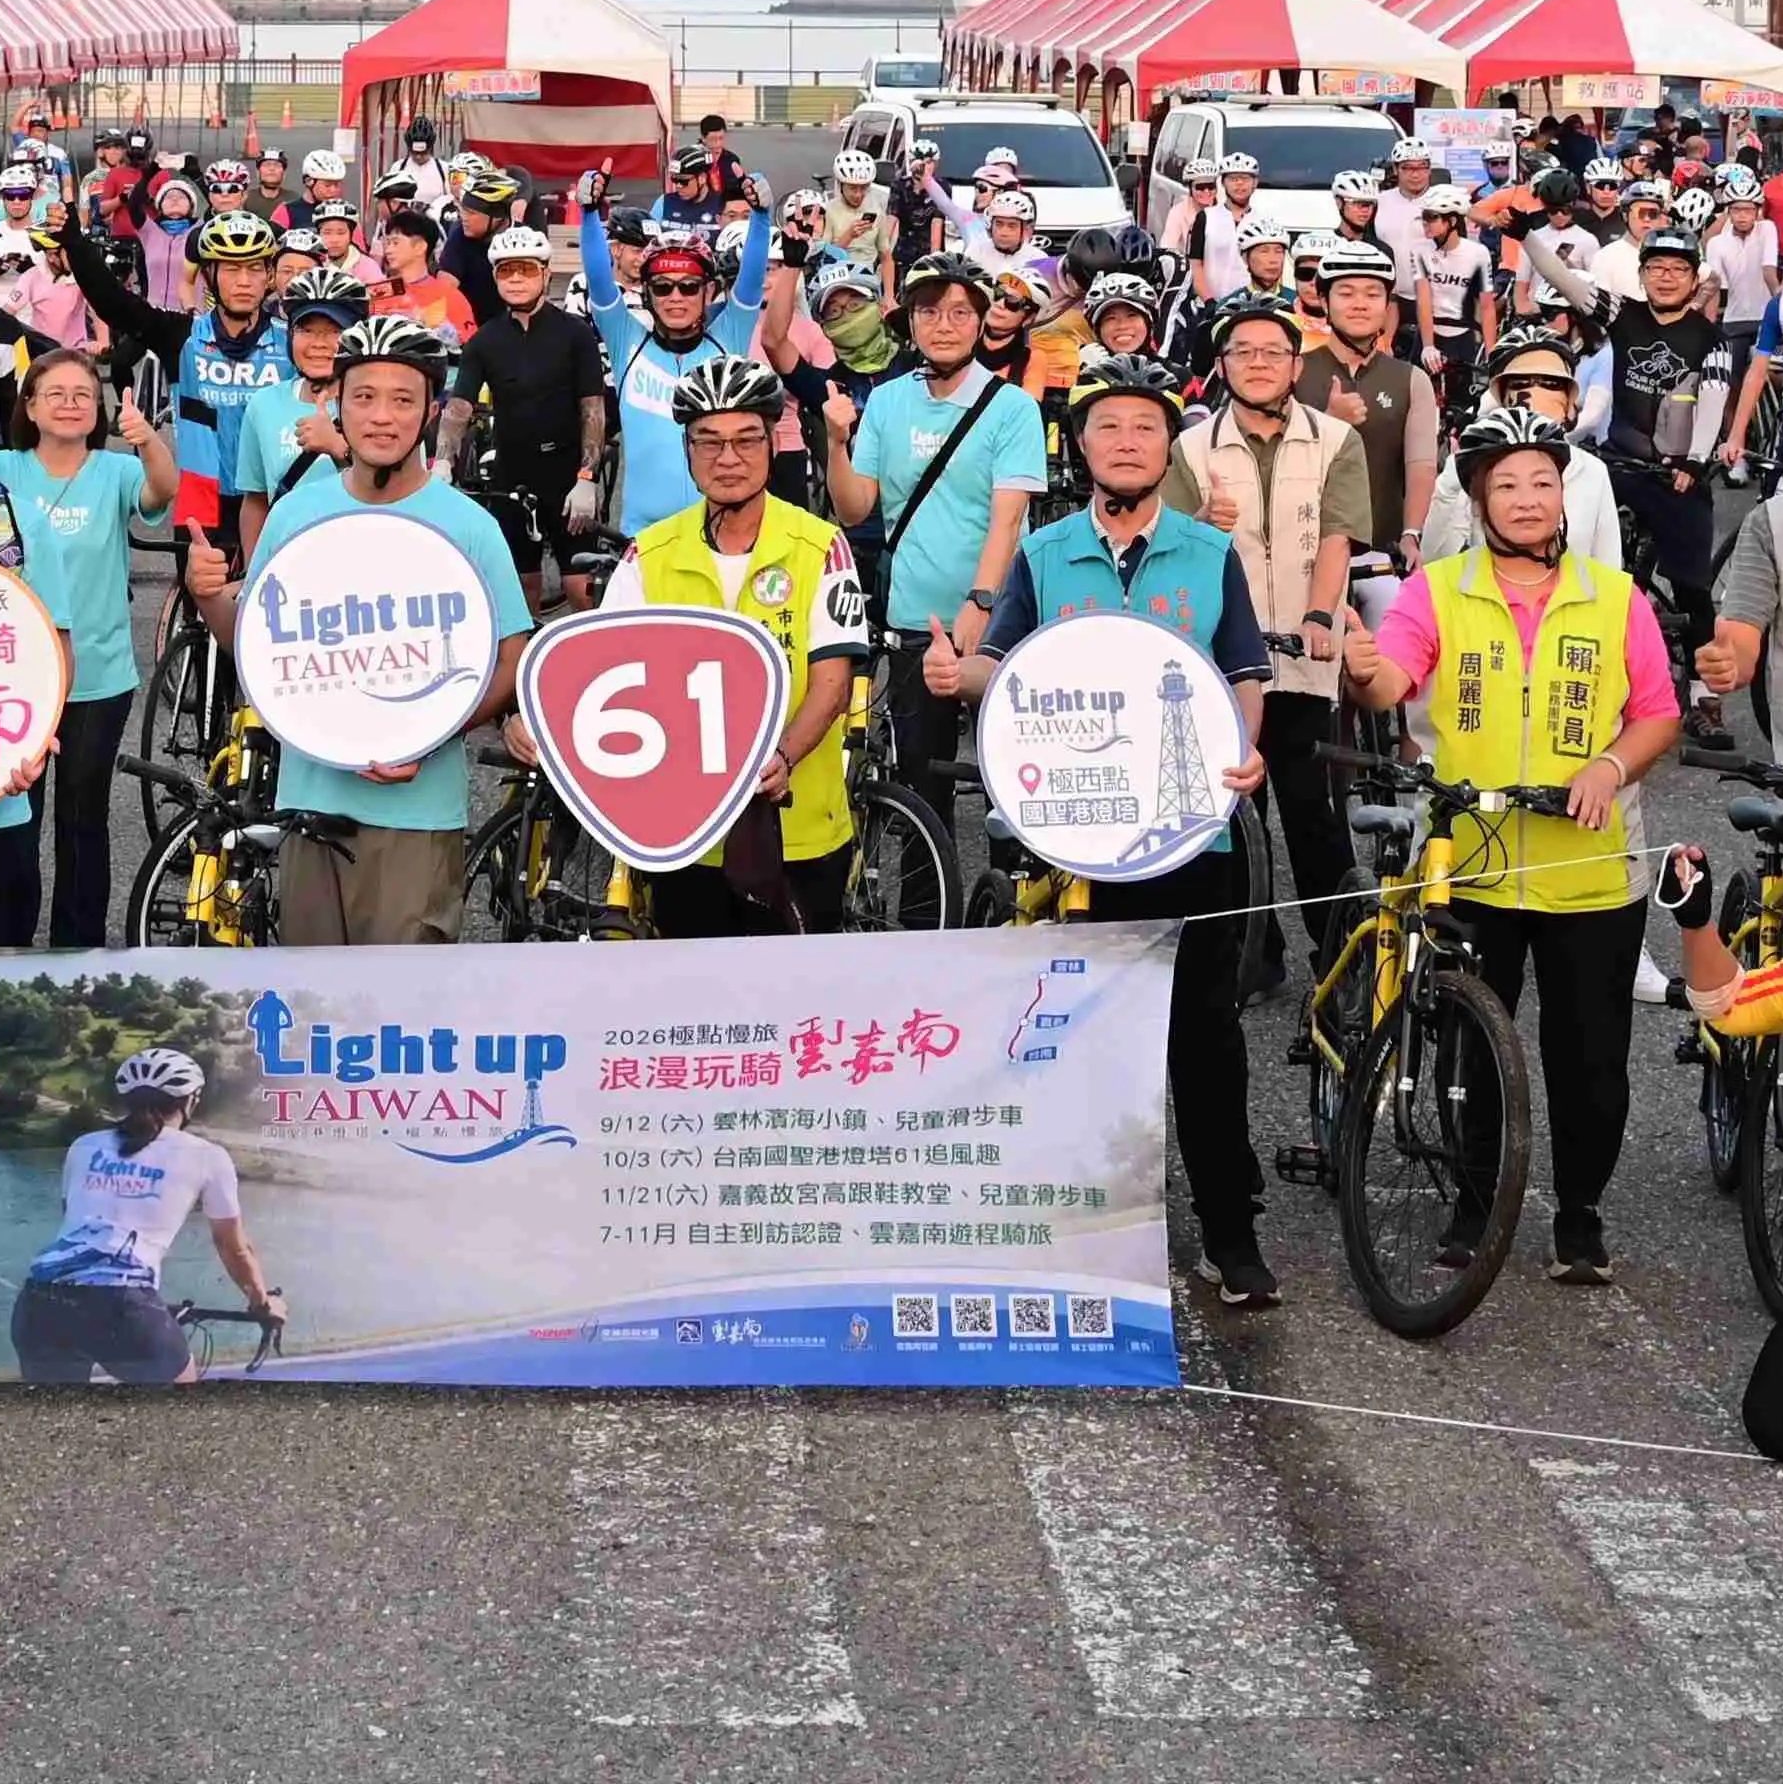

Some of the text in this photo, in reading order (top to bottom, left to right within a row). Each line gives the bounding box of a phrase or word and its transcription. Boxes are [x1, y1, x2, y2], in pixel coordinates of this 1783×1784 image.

[258, 573, 467, 646] Light up
[835, 580, 865, 629] hp
[272, 640, 432, 682] TAIWAN
[1006, 671, 1126, 716] Light up
[1457, 652, 1482, 733] 周麗那
[1562, 645, 1593, 747] 賴惠員
[572, 660, 728, 779] 61
[1014, 717, 1105, 738] TAIWAN
[1047, 764, 1130, 795] 極西點
[1020, 797, 1140, 827] 國聖港燈塔
[247, 990, 567, 1084] Light up
[604, 1022, 778, 1047] 2026極點慢旅
[600, 1049, 782, 1092] 浪漫玩騎
[263, 1088, 506, 1122] TAIWAN
[601, 1115, 651, 1135] 9/12
[714, 1104, 1024, 1133] 雲林濱海小鎮、兒童滑步車
[88, 1150, 166, 1182] Light up
[602, 1149, 650, 1169] 10/3
[713, 1141, 1002, 1169] 台南國聖港燈塔61追風趣
[718, 1180, 1108, 1209] 嘉義故宮高跟鞋教堂、兒童滑步車
[601, 1220, 1054, 1248] 7-11月 自主到訪認證、雲嘉南遊程騎旅
